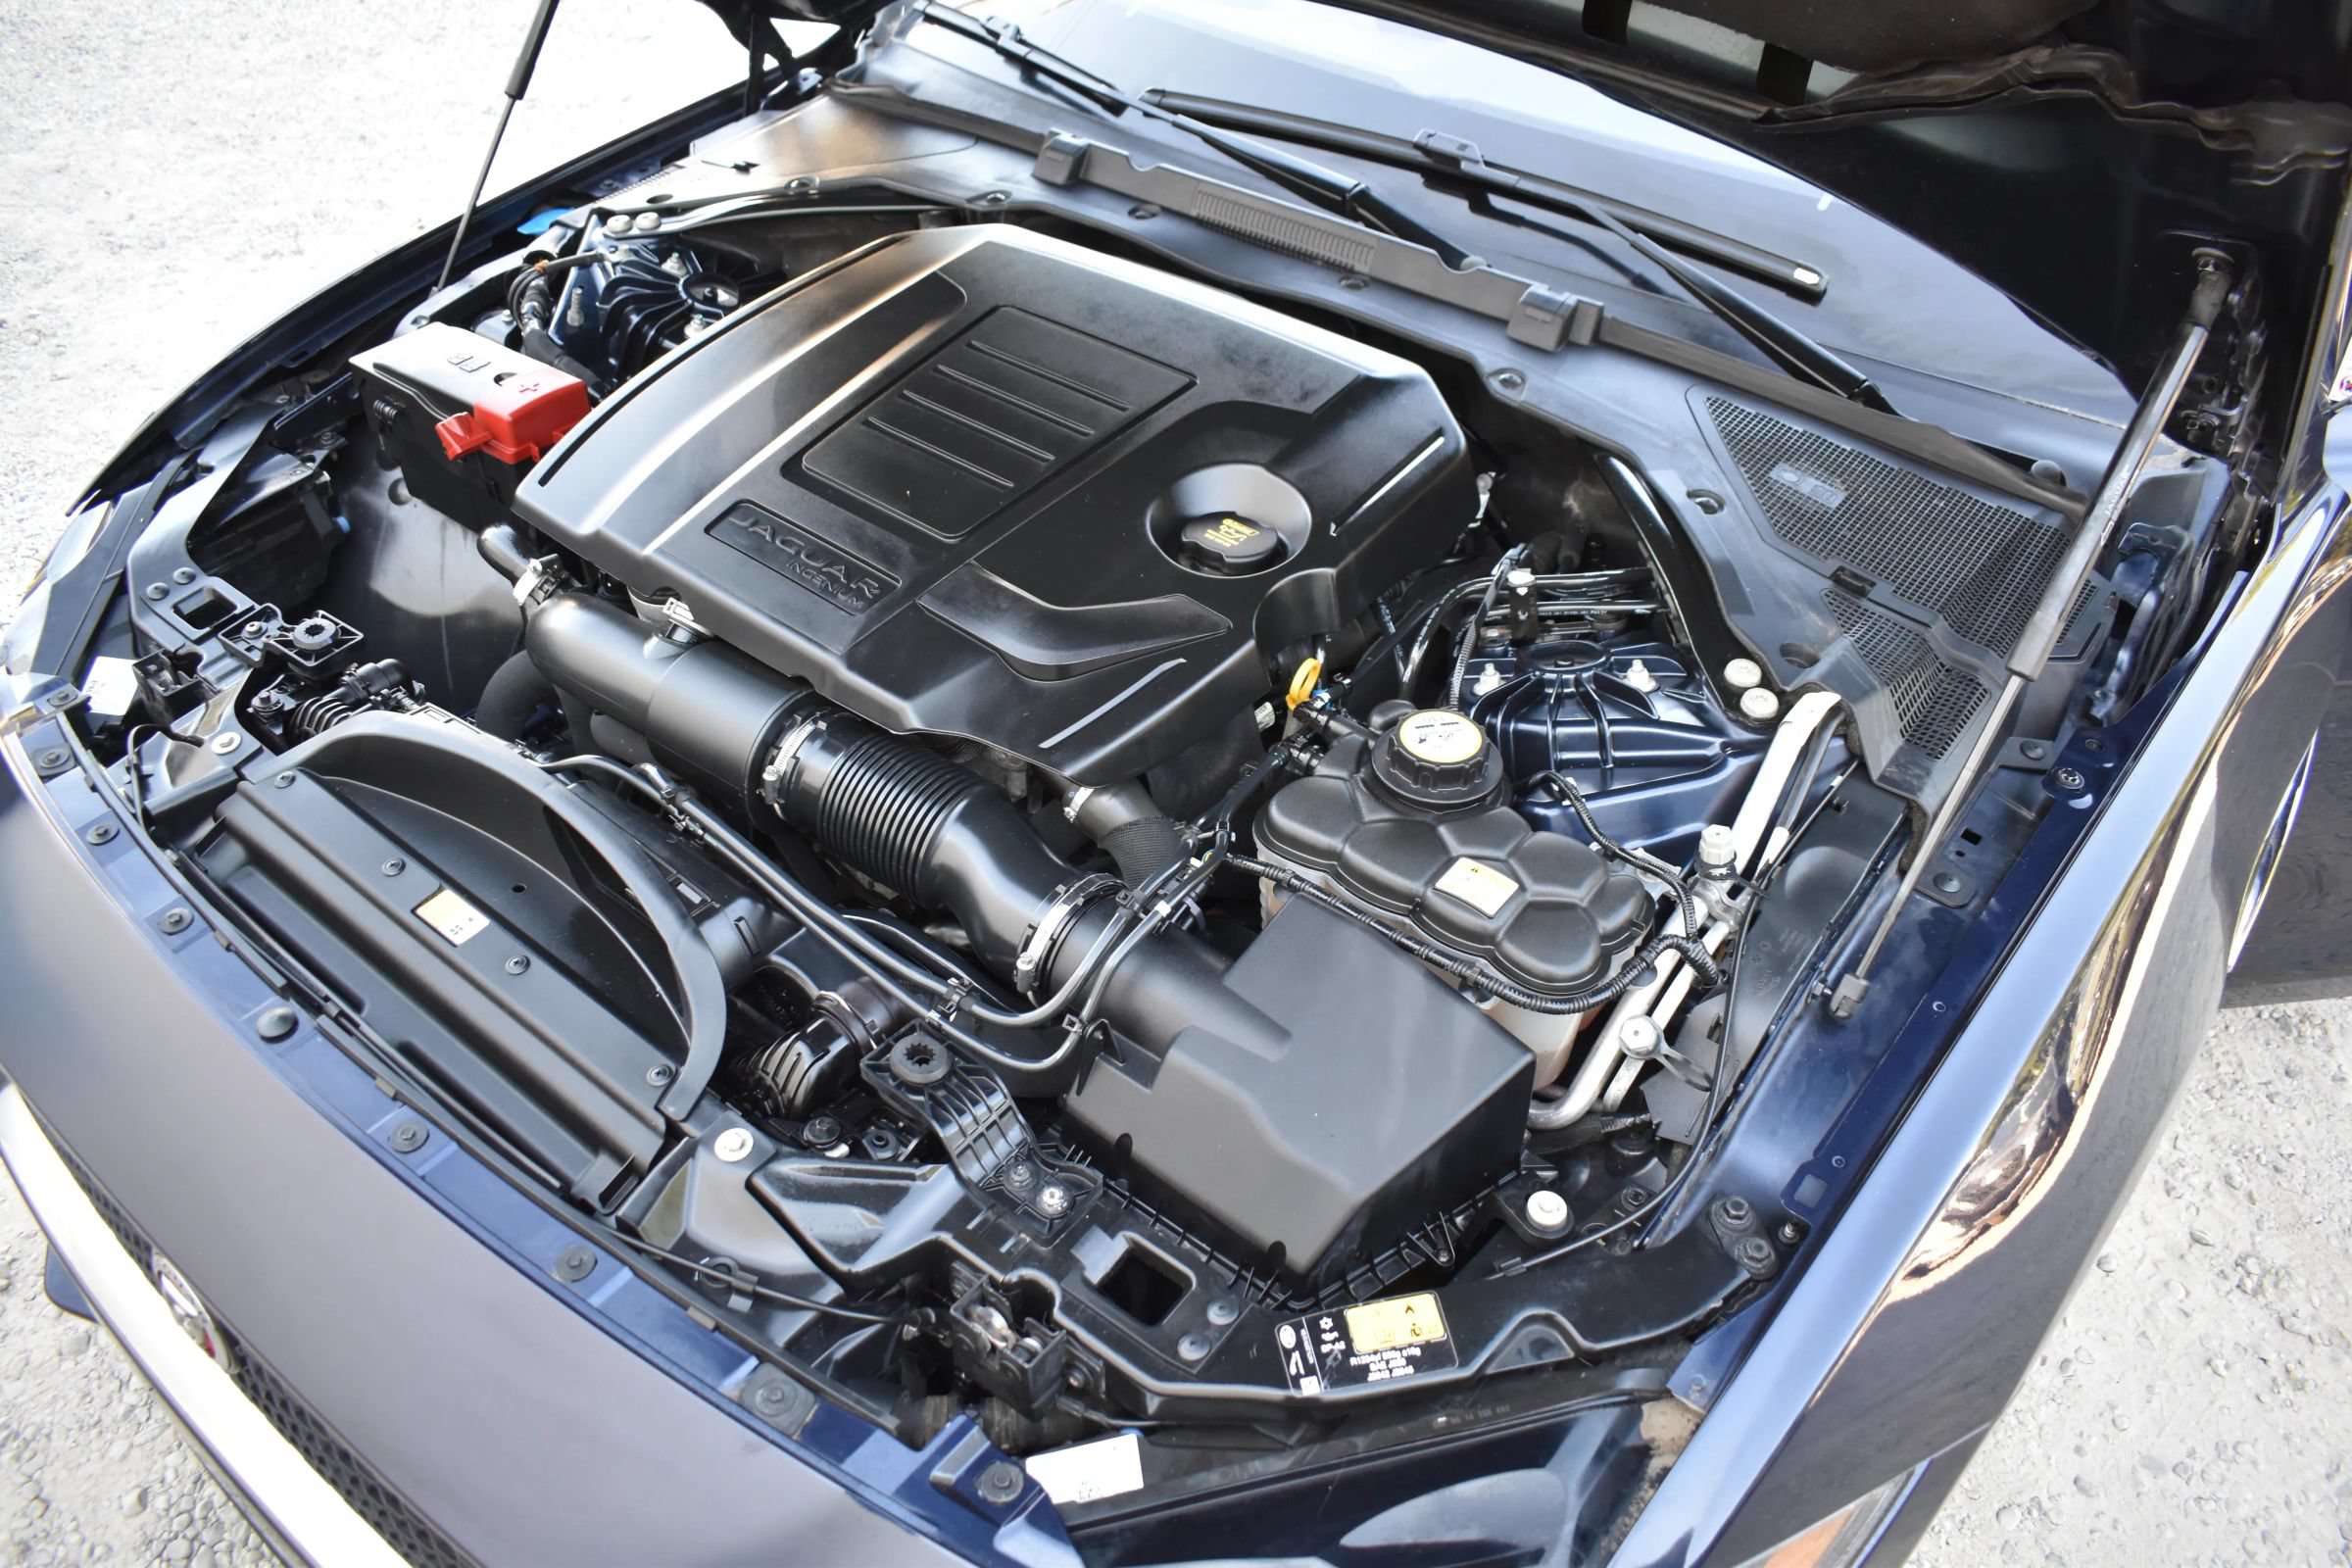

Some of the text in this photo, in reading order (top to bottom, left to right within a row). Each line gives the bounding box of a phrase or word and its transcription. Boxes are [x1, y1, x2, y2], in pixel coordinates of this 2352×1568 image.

[2104, 471, 2131, 516] JAGUAR
[729, 516, 880, 599] JAGUAR
[786, 559, 864, 609] INGENIUM
